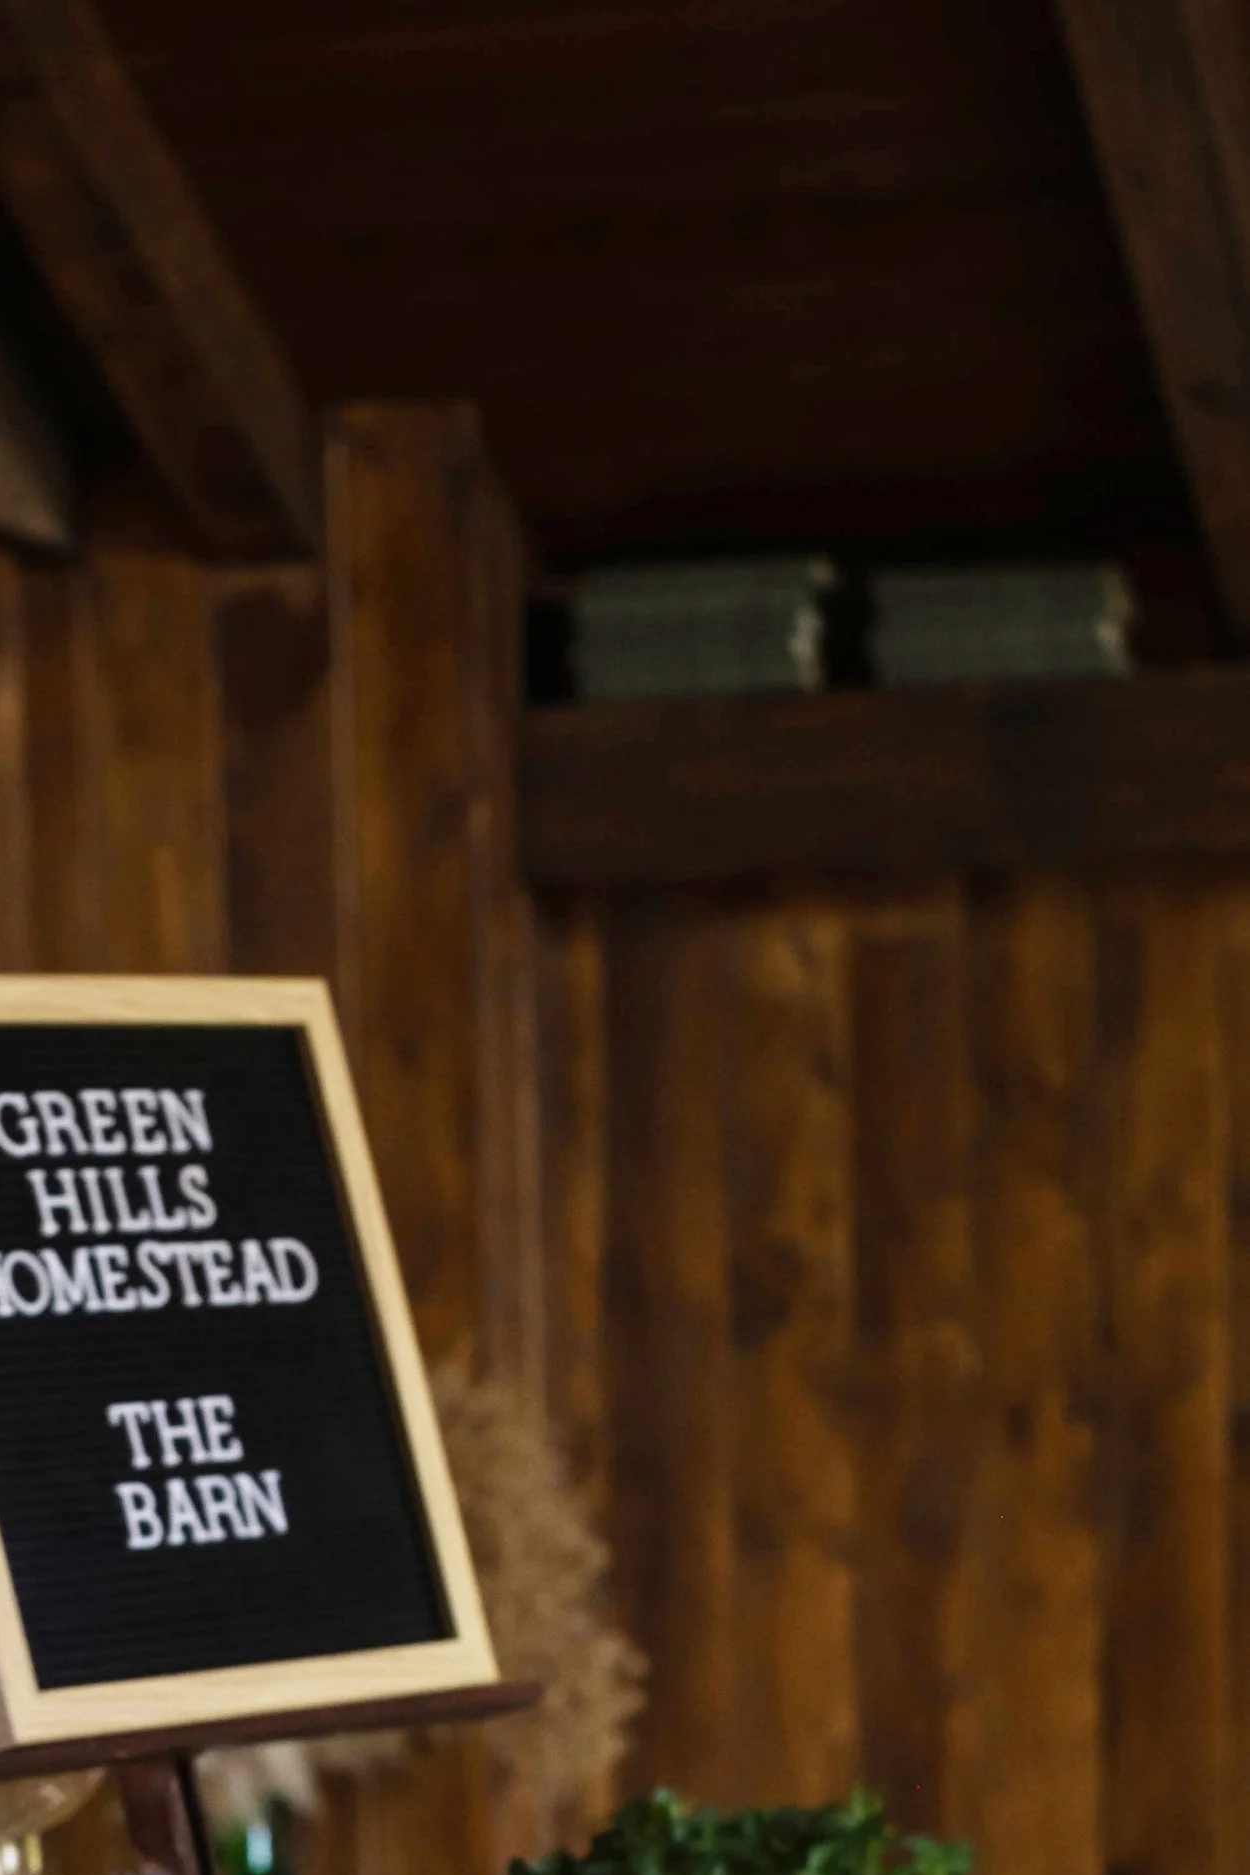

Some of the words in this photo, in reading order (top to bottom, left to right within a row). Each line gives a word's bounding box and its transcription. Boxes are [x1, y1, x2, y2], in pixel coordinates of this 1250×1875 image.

[26, 1164, 218, 1237] HILLS
[107, 1395, 244, 1469] THE
[115, 1470, 288, 1550] BARN
